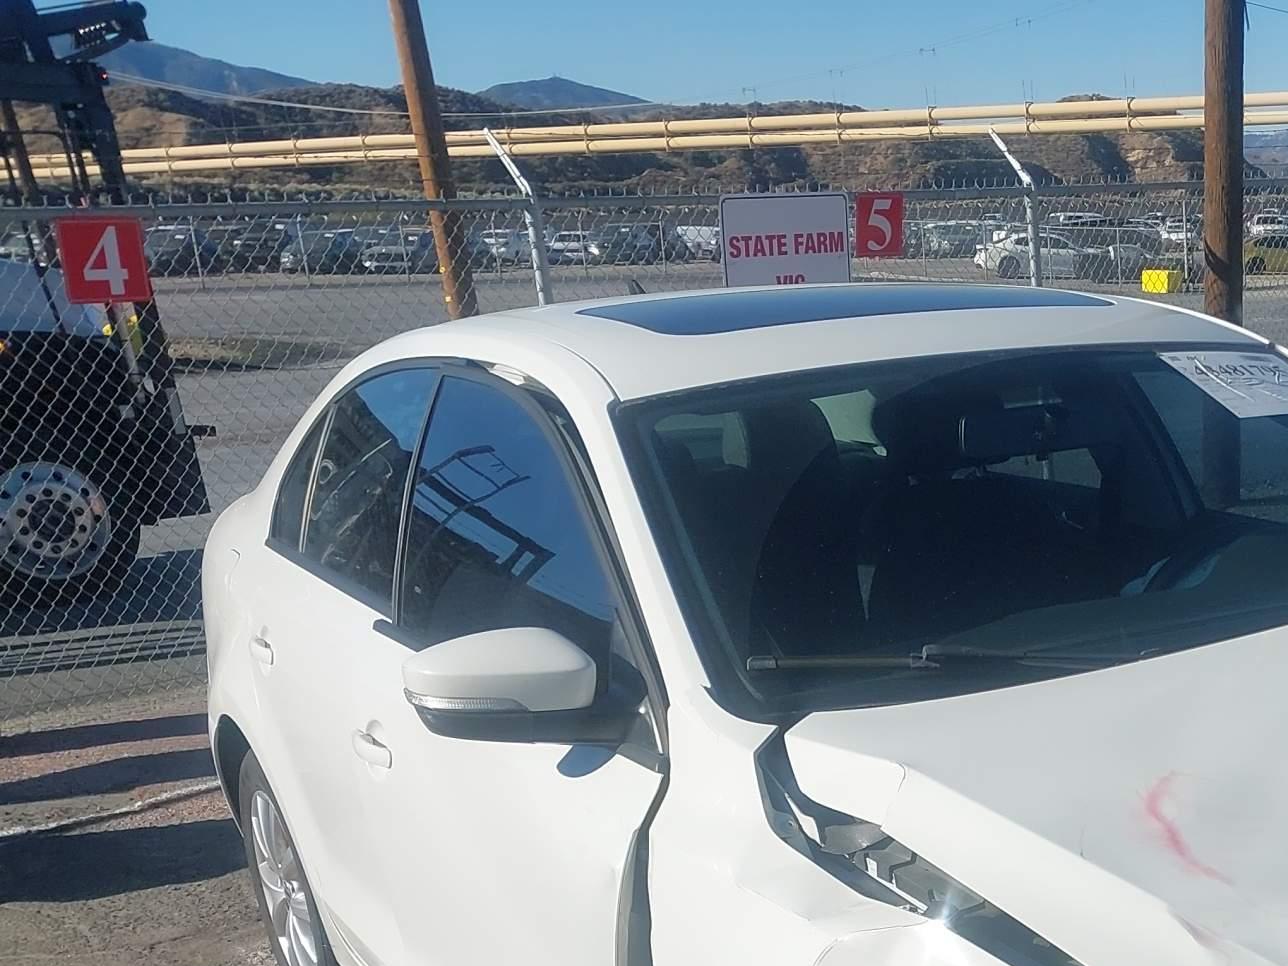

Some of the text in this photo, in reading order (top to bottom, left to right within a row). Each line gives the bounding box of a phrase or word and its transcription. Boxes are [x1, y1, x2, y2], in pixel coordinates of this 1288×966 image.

[728, 231, 844, 258] STATE FARM
[867, 199, 892, 250] 5
[83, 226, 128, 295] 4
